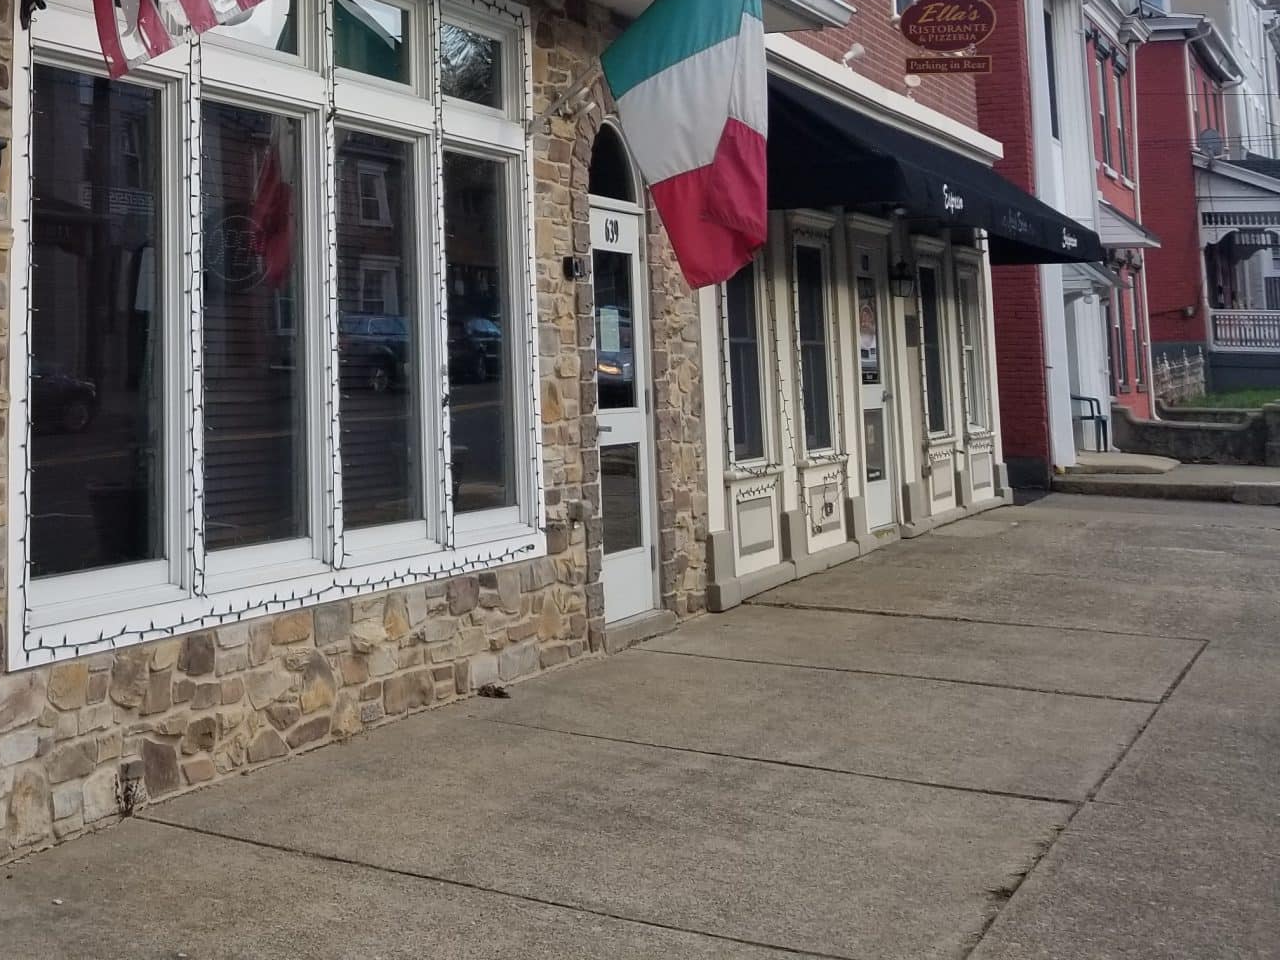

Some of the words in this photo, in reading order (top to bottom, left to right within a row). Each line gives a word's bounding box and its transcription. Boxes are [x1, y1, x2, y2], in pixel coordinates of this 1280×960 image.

[918, 2, 980, 23] Ella's
[909, 23, 989, 35] RISTORANTE
[928, 33, 977, 43] PIZZERIA
[910, 60, 948, 71] Parking
[950, 60, 960, 69] in
[963, 59, 987, 69] Rear
[604, 217, 620, 244] 639
